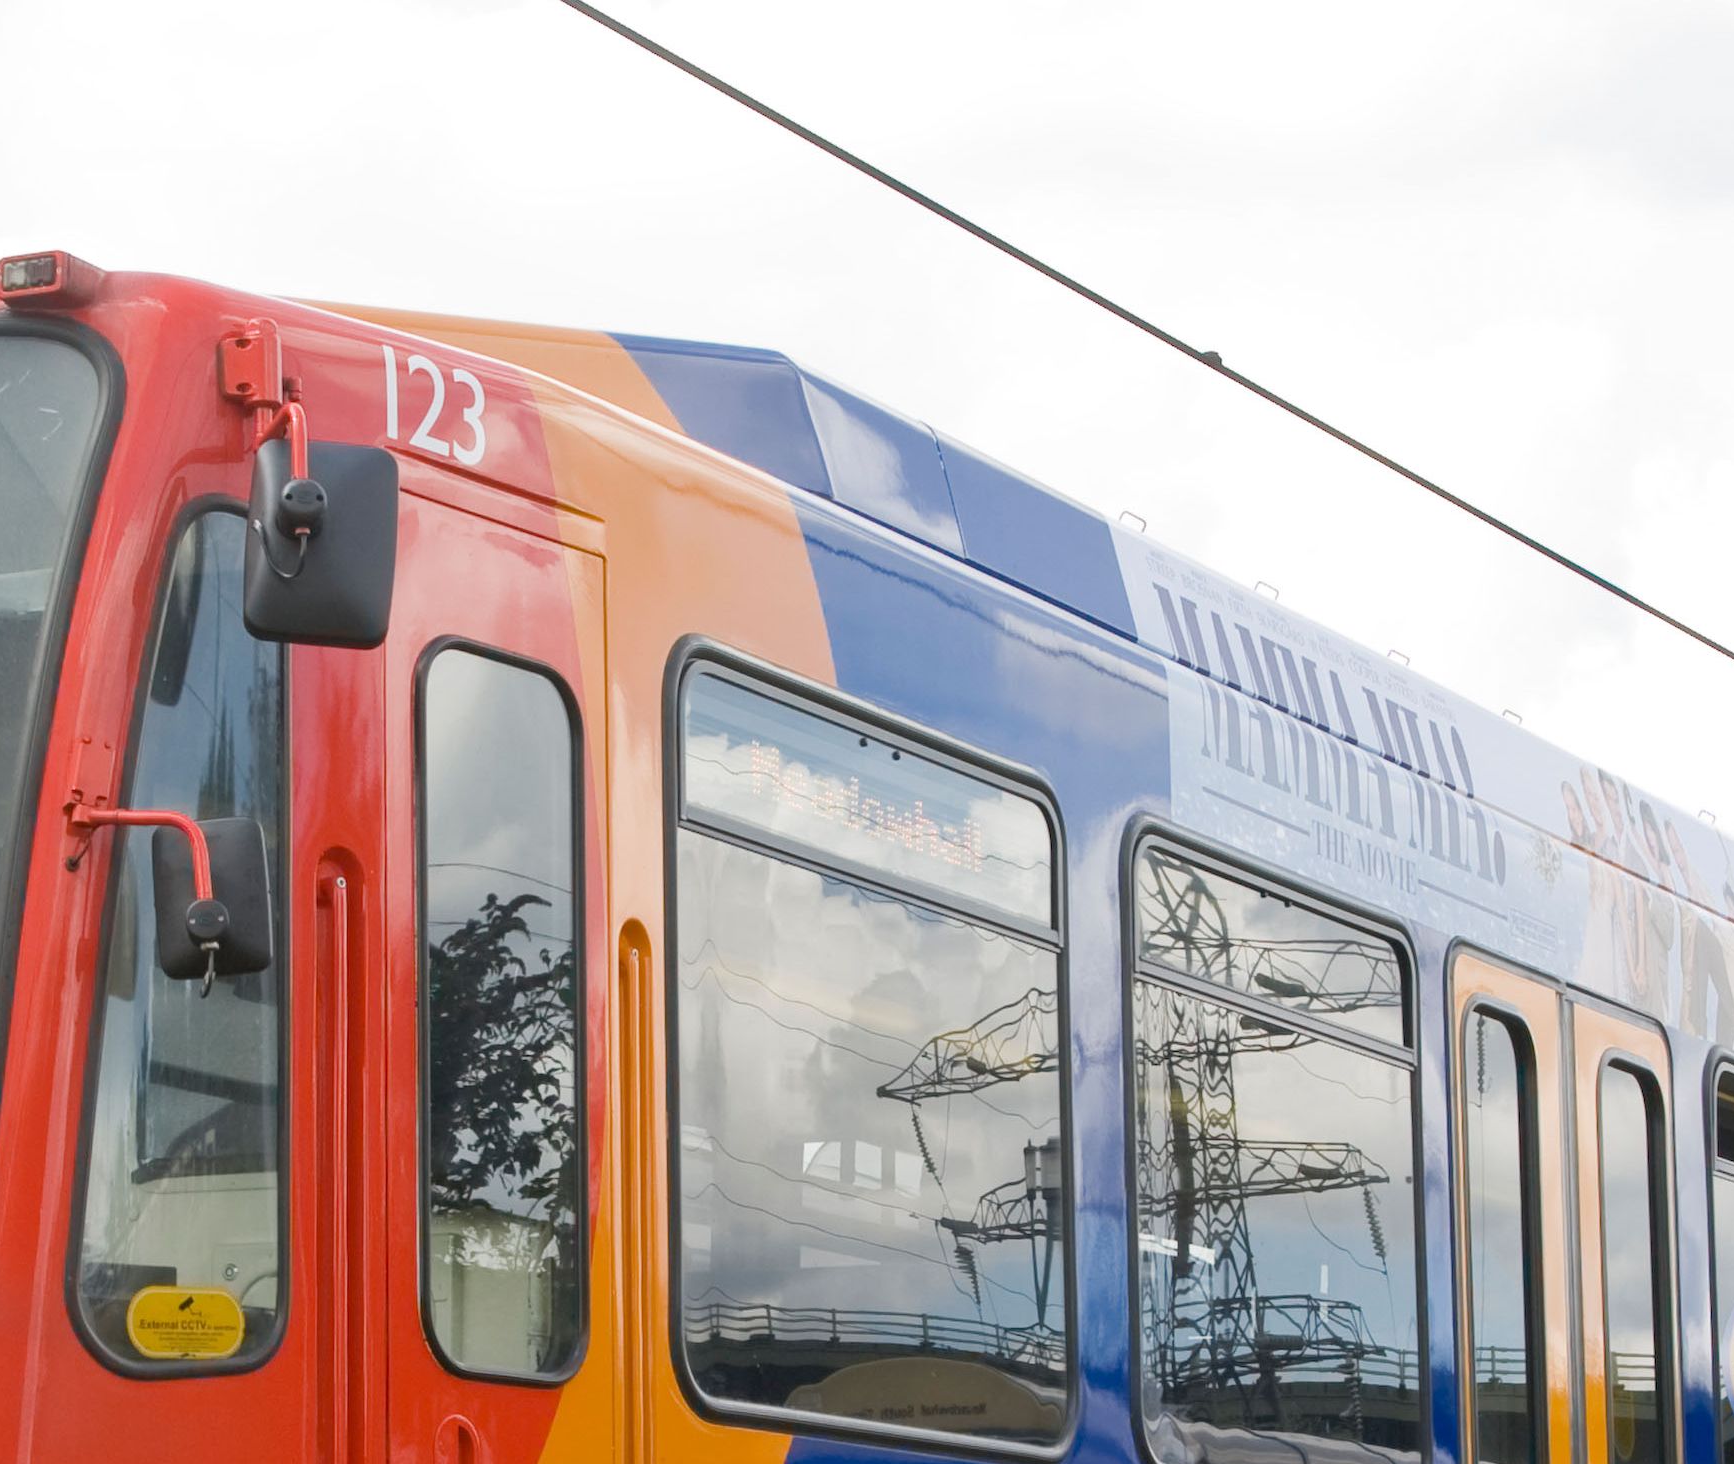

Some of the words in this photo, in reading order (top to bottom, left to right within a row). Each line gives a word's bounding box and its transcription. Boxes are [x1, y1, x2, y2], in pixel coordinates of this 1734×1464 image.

[381, 344, 487, 466] 123
[1310, 819, 1352, 870] THE
[1355, 838, 1418, 896] MOVIE
[139, 1319, 179, 1330] External
[181, 1320, 207, 1331] CCTV
